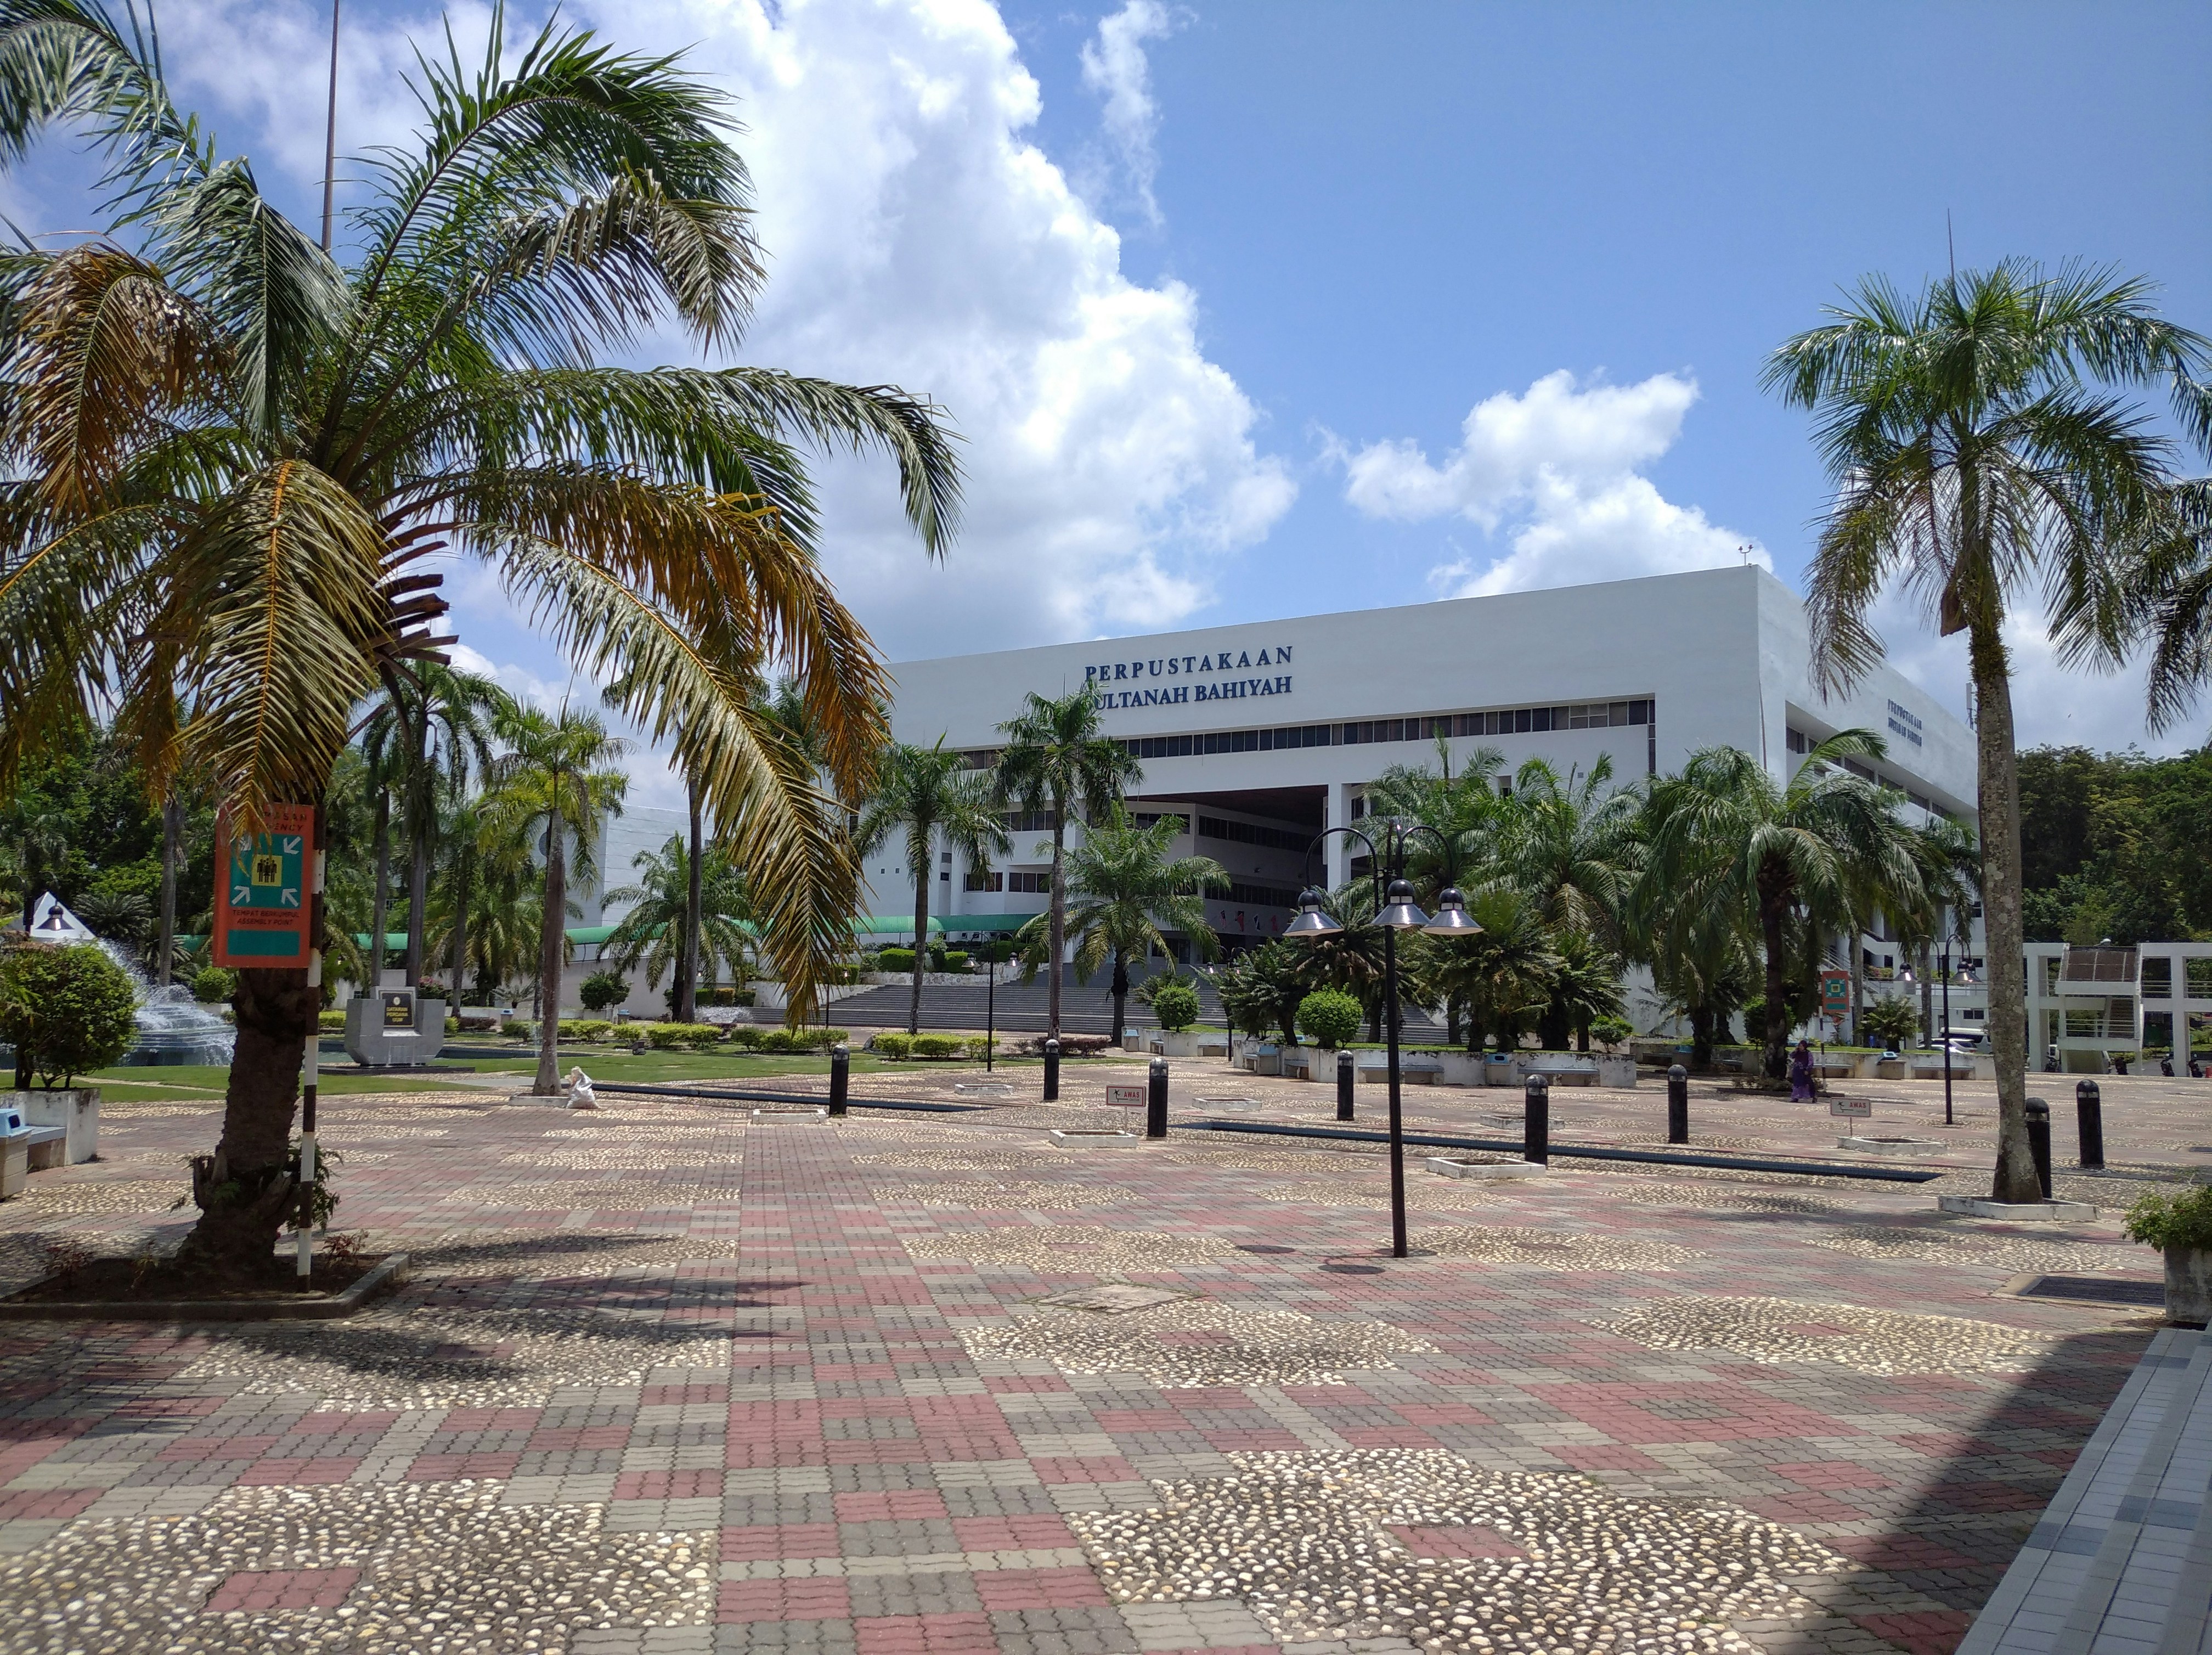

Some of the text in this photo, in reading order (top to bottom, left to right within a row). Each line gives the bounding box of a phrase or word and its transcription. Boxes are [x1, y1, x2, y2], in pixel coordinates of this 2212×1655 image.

[1085, 645, 1293, 682] PERPUSTAKAAN
[1089, 675, 1293, 711] ULTANAH BAHIYAH
